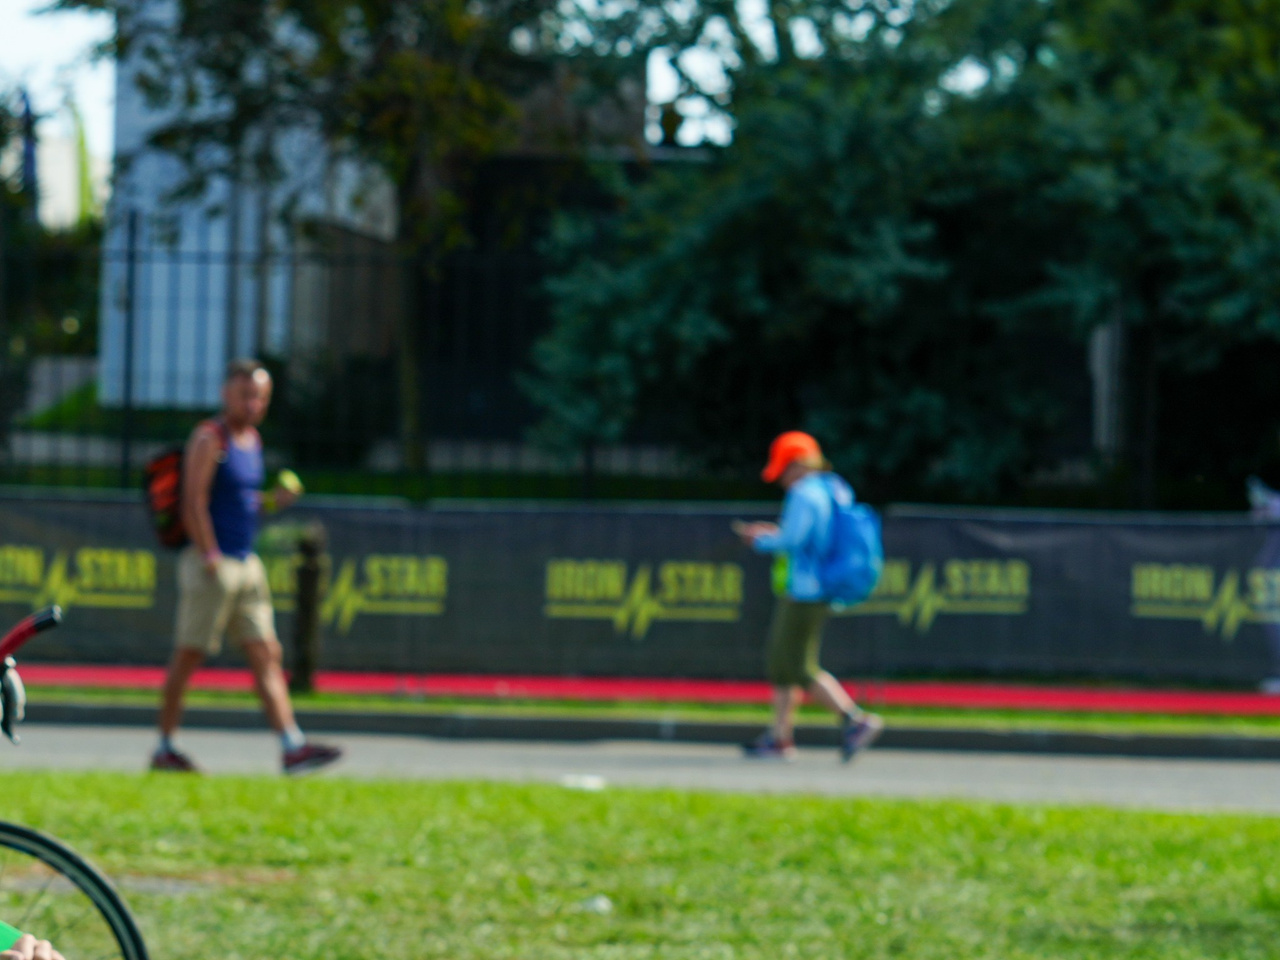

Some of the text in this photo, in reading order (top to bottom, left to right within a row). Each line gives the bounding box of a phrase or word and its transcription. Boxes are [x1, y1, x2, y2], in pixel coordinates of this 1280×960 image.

[77, 549, 156, 589] STAR
[365, 555, 447, 597] STAR
[547, 560, 742, 602] IRON STAR
[946, 559, 1029, 596] STAR
[1131, 564, 1214, 600] IRON
